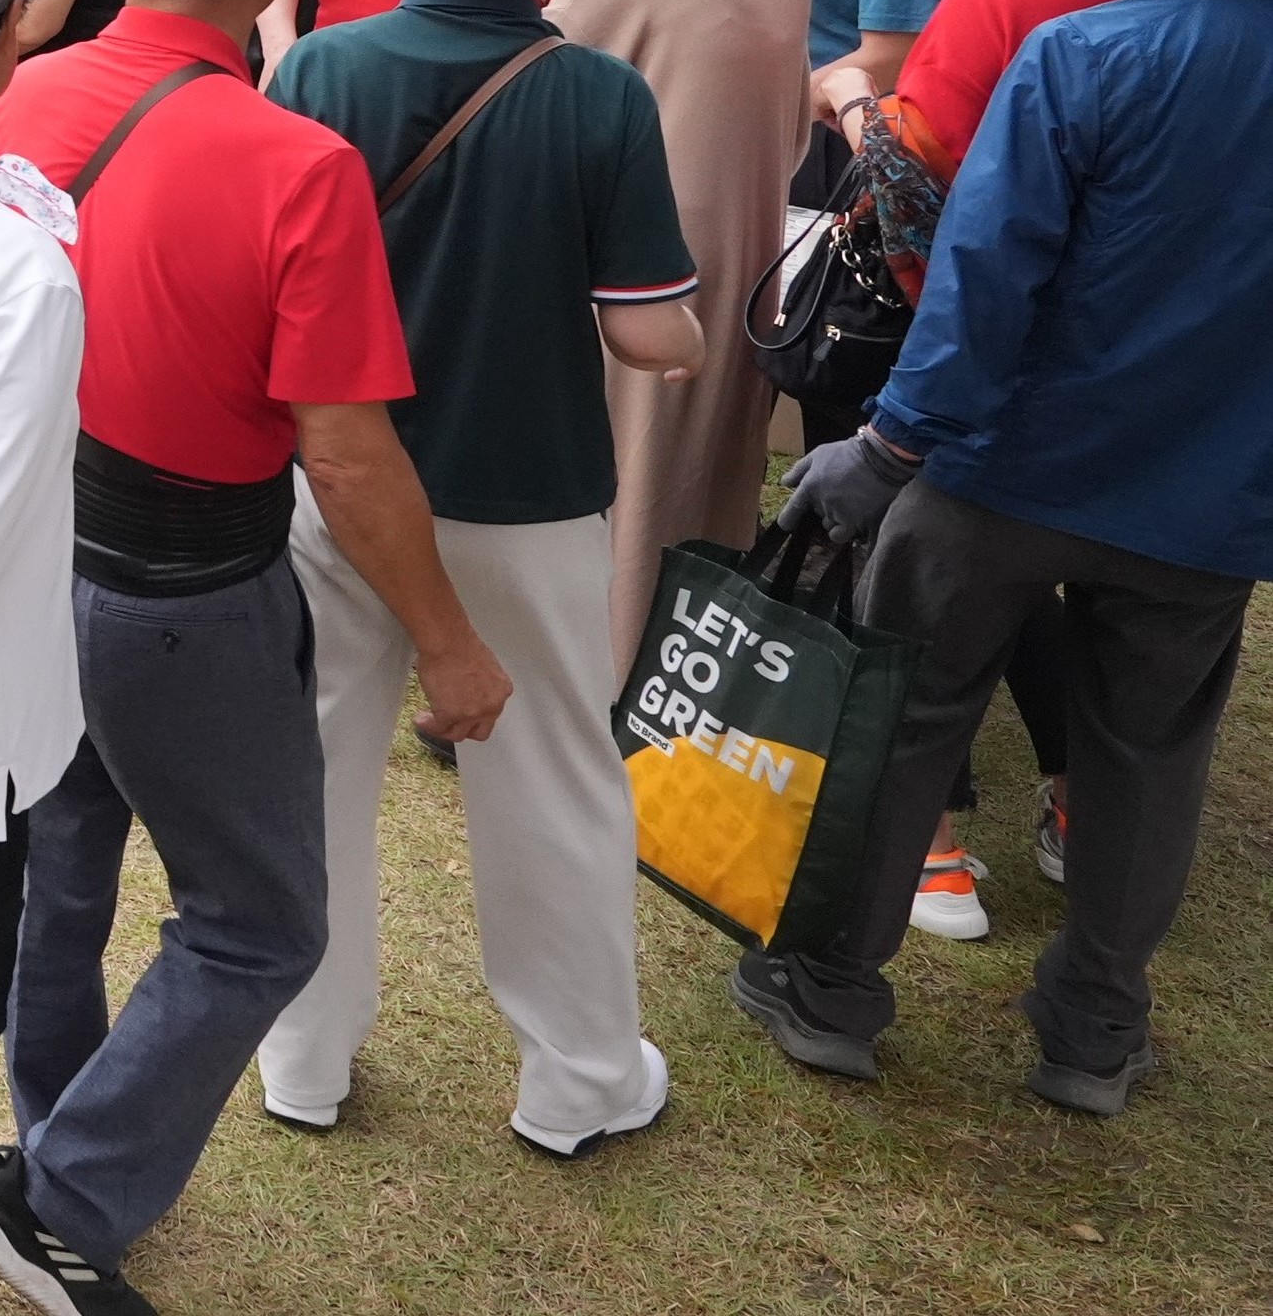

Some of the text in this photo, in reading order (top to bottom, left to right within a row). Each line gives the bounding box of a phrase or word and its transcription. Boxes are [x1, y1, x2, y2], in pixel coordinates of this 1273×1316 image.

[660, 633, 721, 694] GO
[629, 716, 671, 752] No Brand
[638, 675, 796, 796] GREEN
